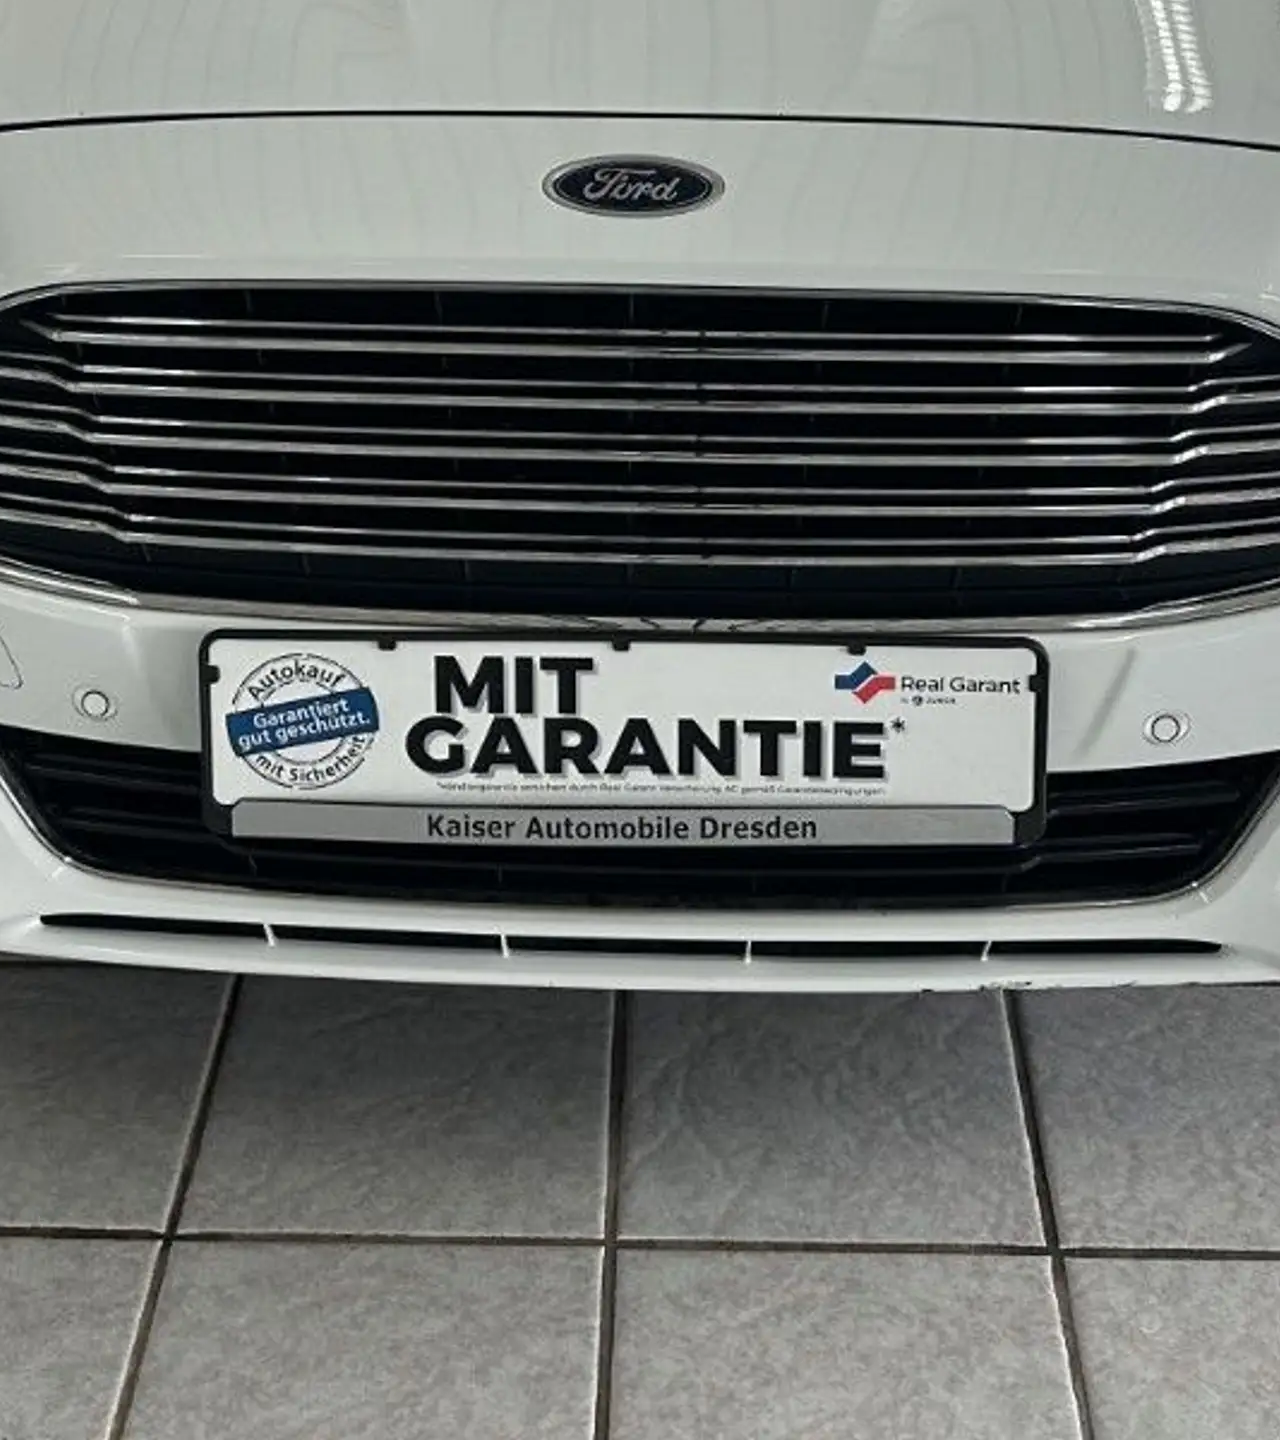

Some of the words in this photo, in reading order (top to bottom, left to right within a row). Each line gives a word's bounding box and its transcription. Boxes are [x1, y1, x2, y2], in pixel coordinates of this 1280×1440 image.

[582, 167, 681, 202] Ford
[248, 659, 346, 702] Autokauf
[433, 654, 596, 716] MIT
[900, 675, 945, 693] Real
[948, 675, 1022, 695] Garant
[237, 728, 272, 753] gut
[274, 711, 371, 743] geschützt.
[252, 698, 350, 730] Garantiert
[254, 754, 287, 775] mit
[289, 734, 367, 782] Sicherheit
[426, 814, 517, 839] Kaiser
[524, 814, 690, 840] Automobile
[699, 815, 818, 840] Dresden
